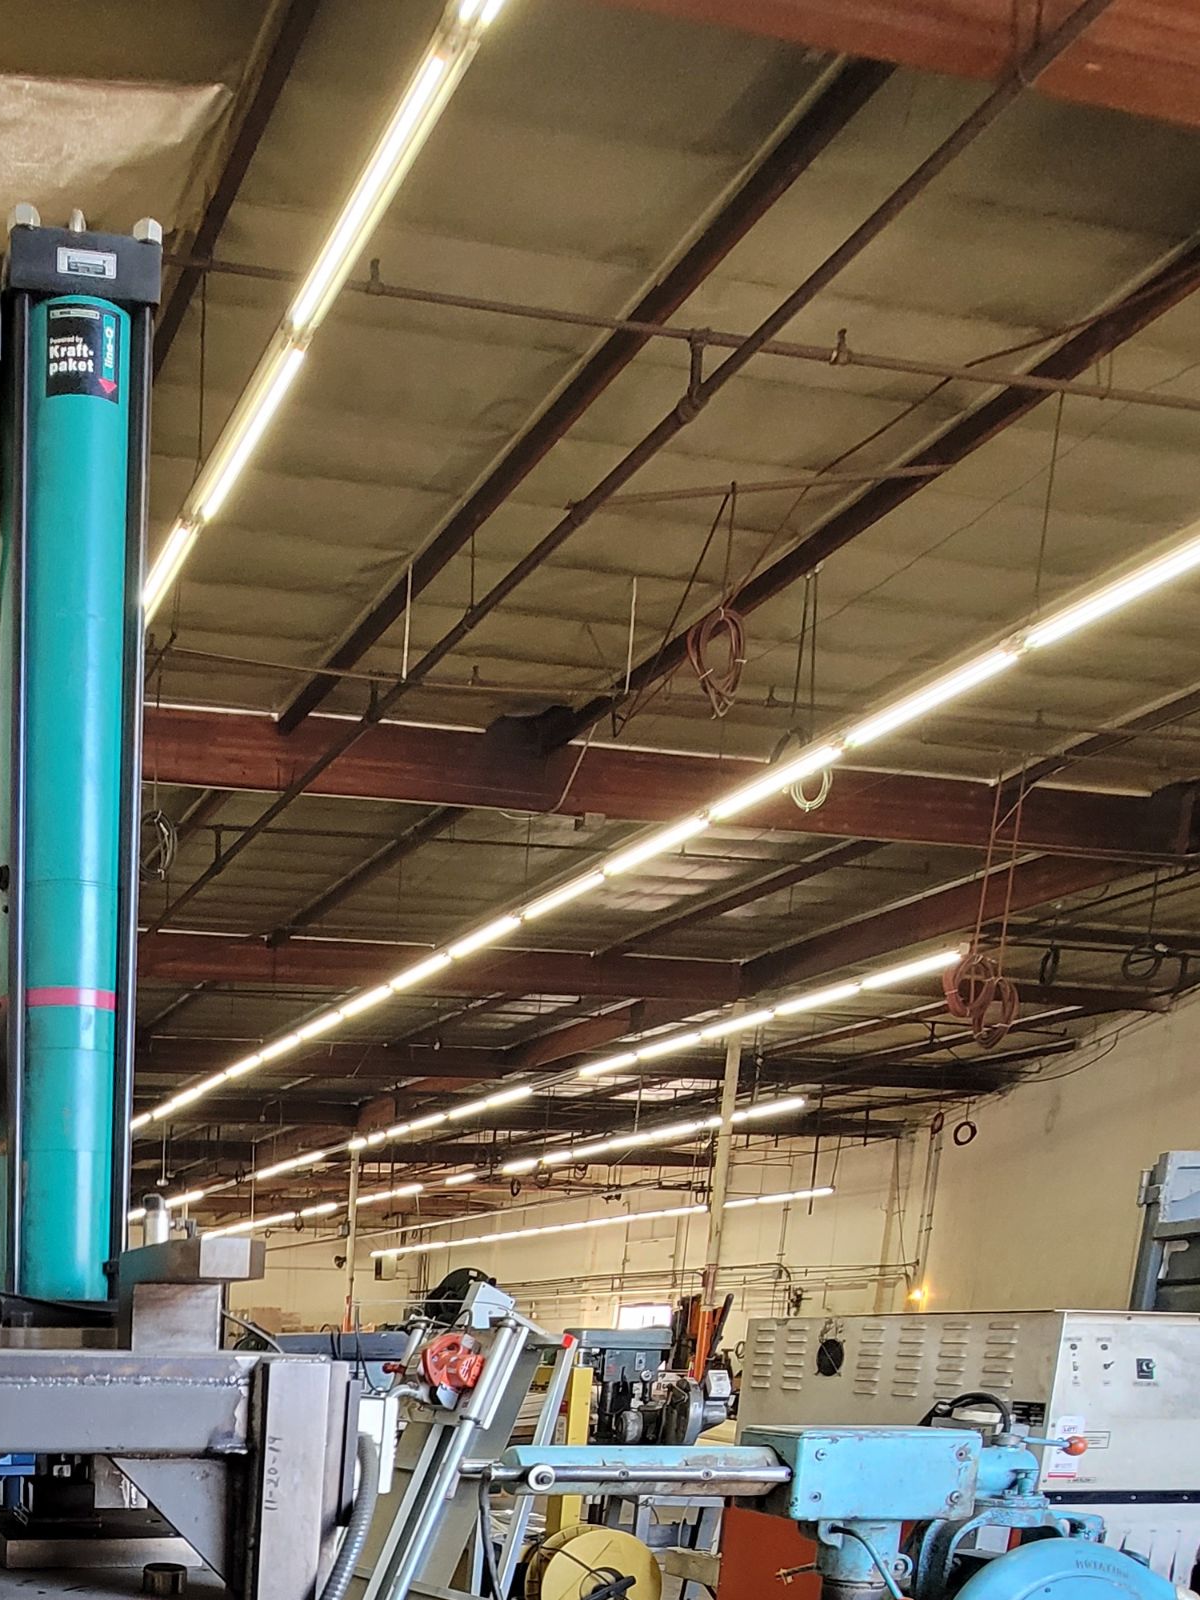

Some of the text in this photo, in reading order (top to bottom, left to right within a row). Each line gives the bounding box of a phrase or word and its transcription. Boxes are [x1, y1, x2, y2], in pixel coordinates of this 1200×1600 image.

[49, 335, 84, 345] Powered by
[49, 344, 95, 359] Kraft-
[49, 358, 95, 376] paket
